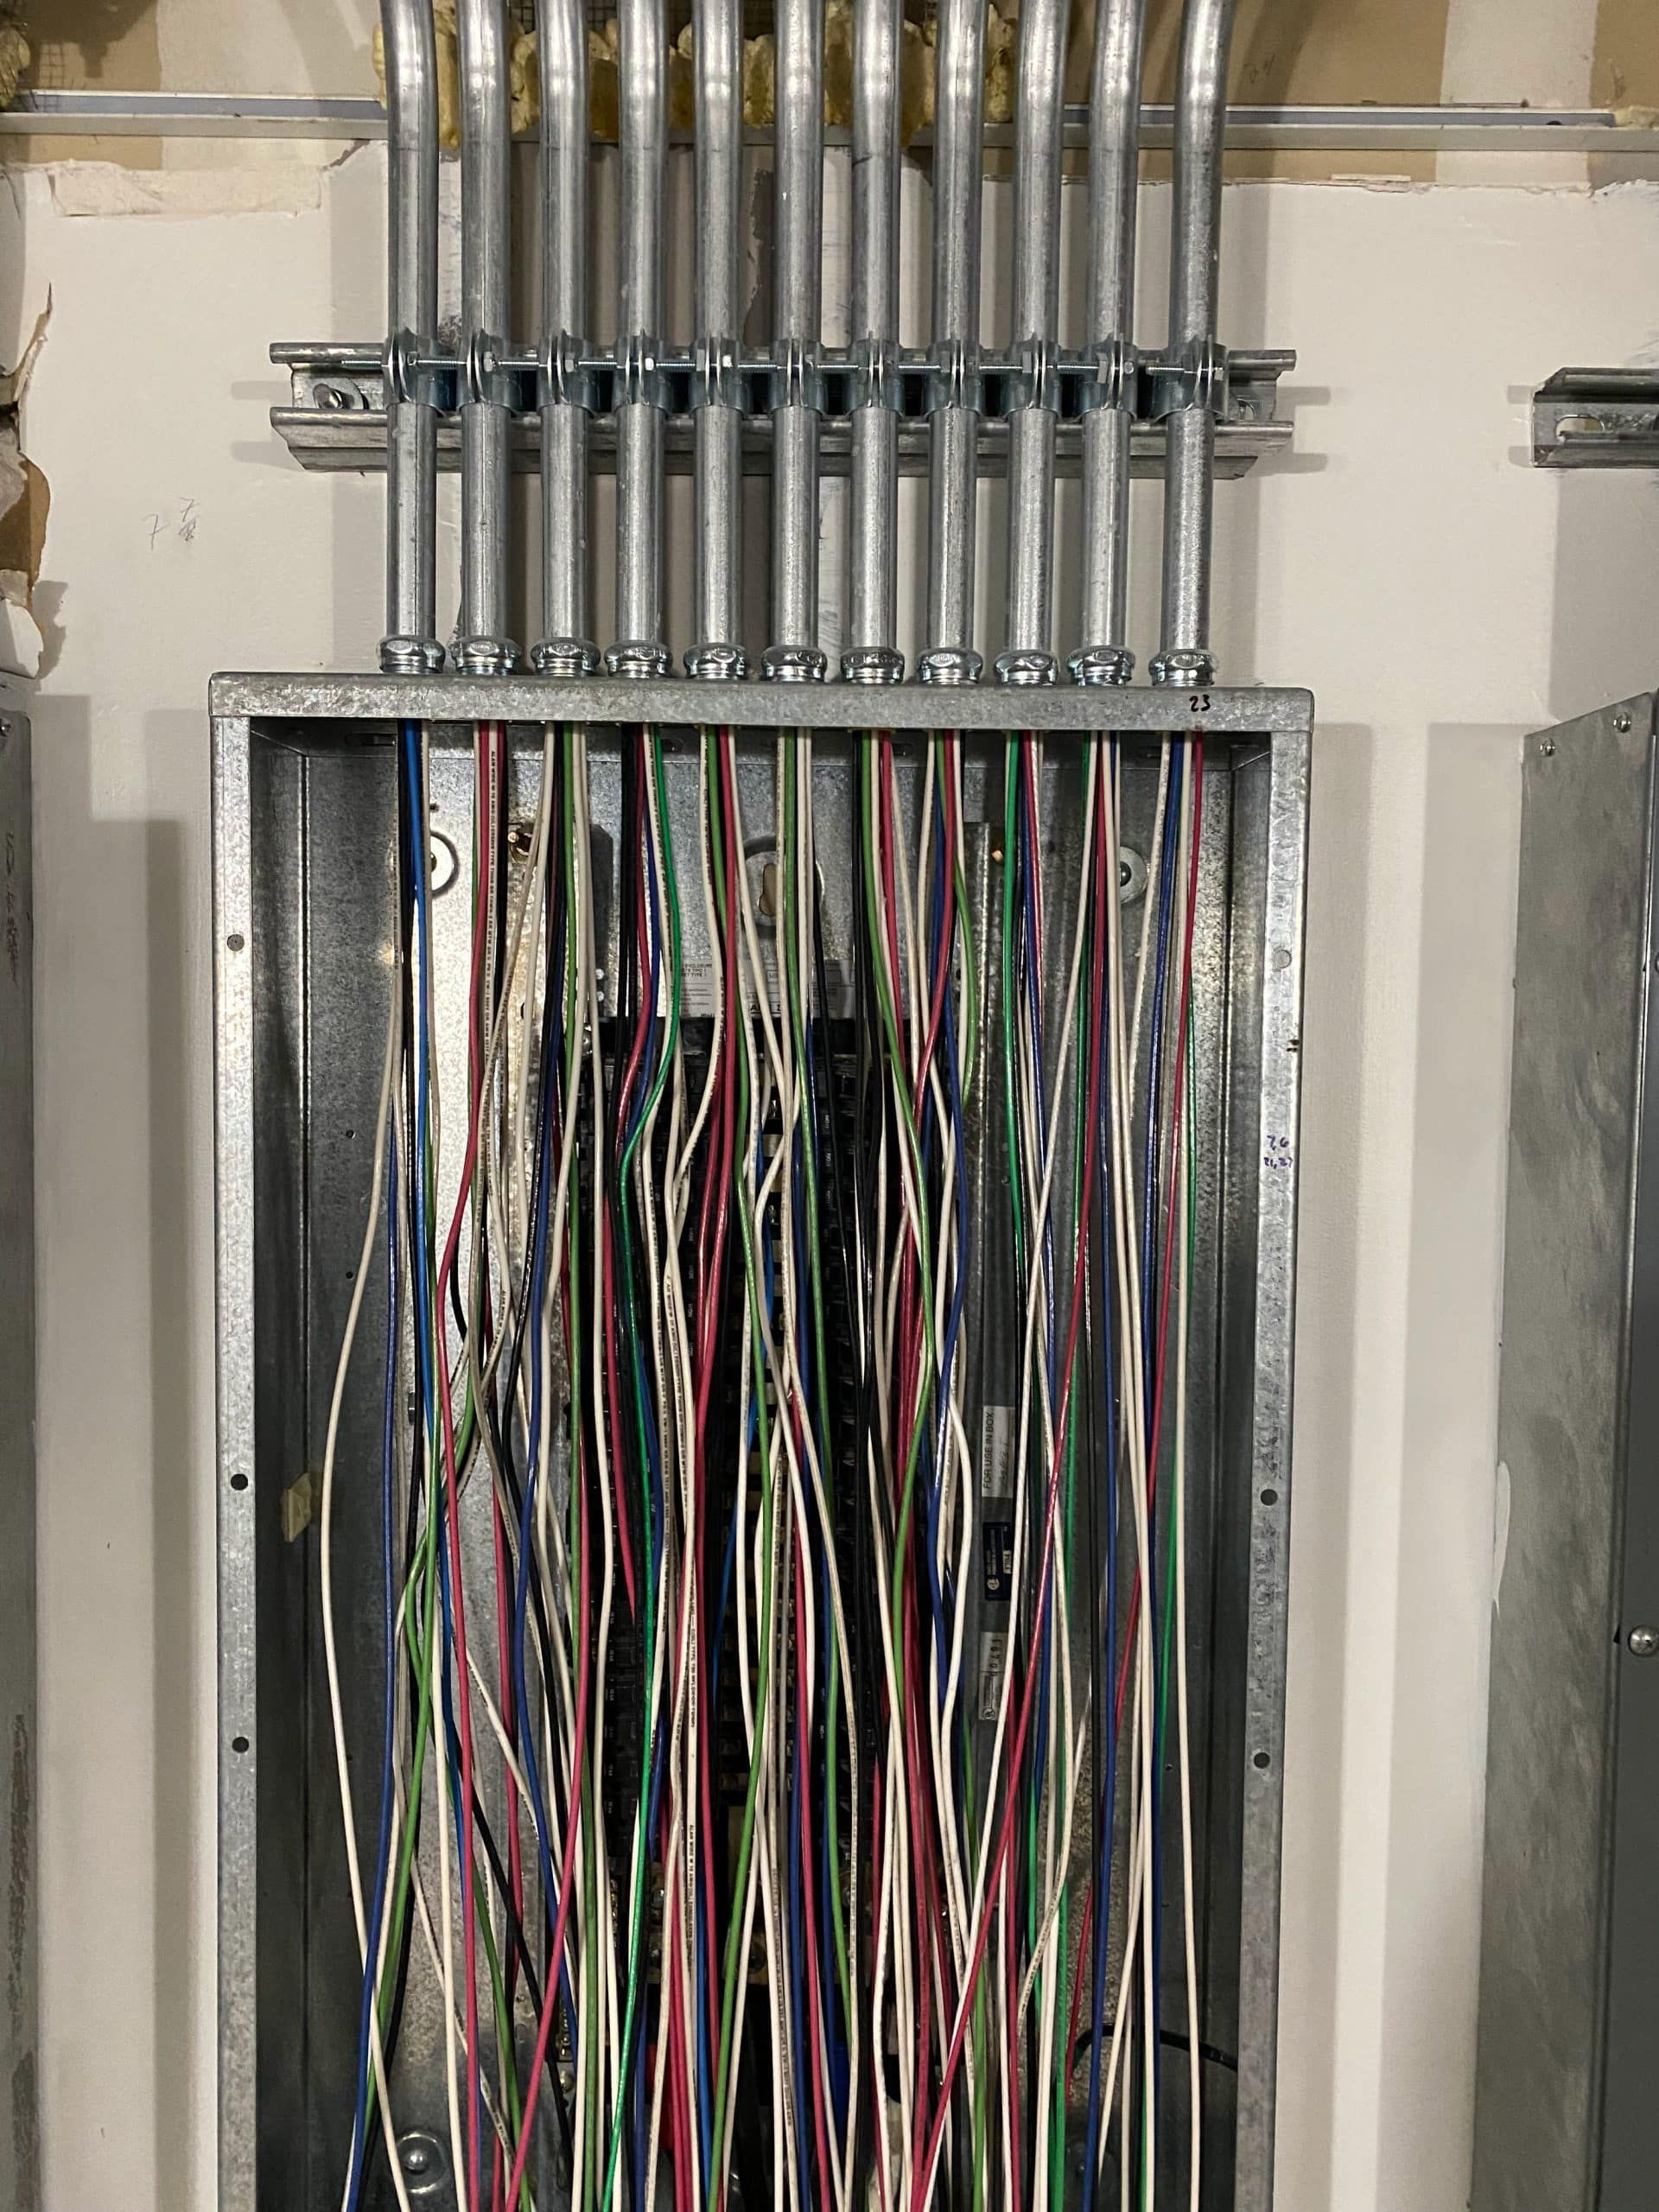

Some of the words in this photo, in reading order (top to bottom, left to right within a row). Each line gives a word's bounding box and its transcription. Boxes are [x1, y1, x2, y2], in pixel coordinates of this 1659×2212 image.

[1189, 694, 1211, 712] 23
[985, 1412, 994, 1433] BOX
[985, 1434, 993, 1445] IN
[984, 1447, 993, 1466] USE
[983, 1470, 992, 1490] FOR
